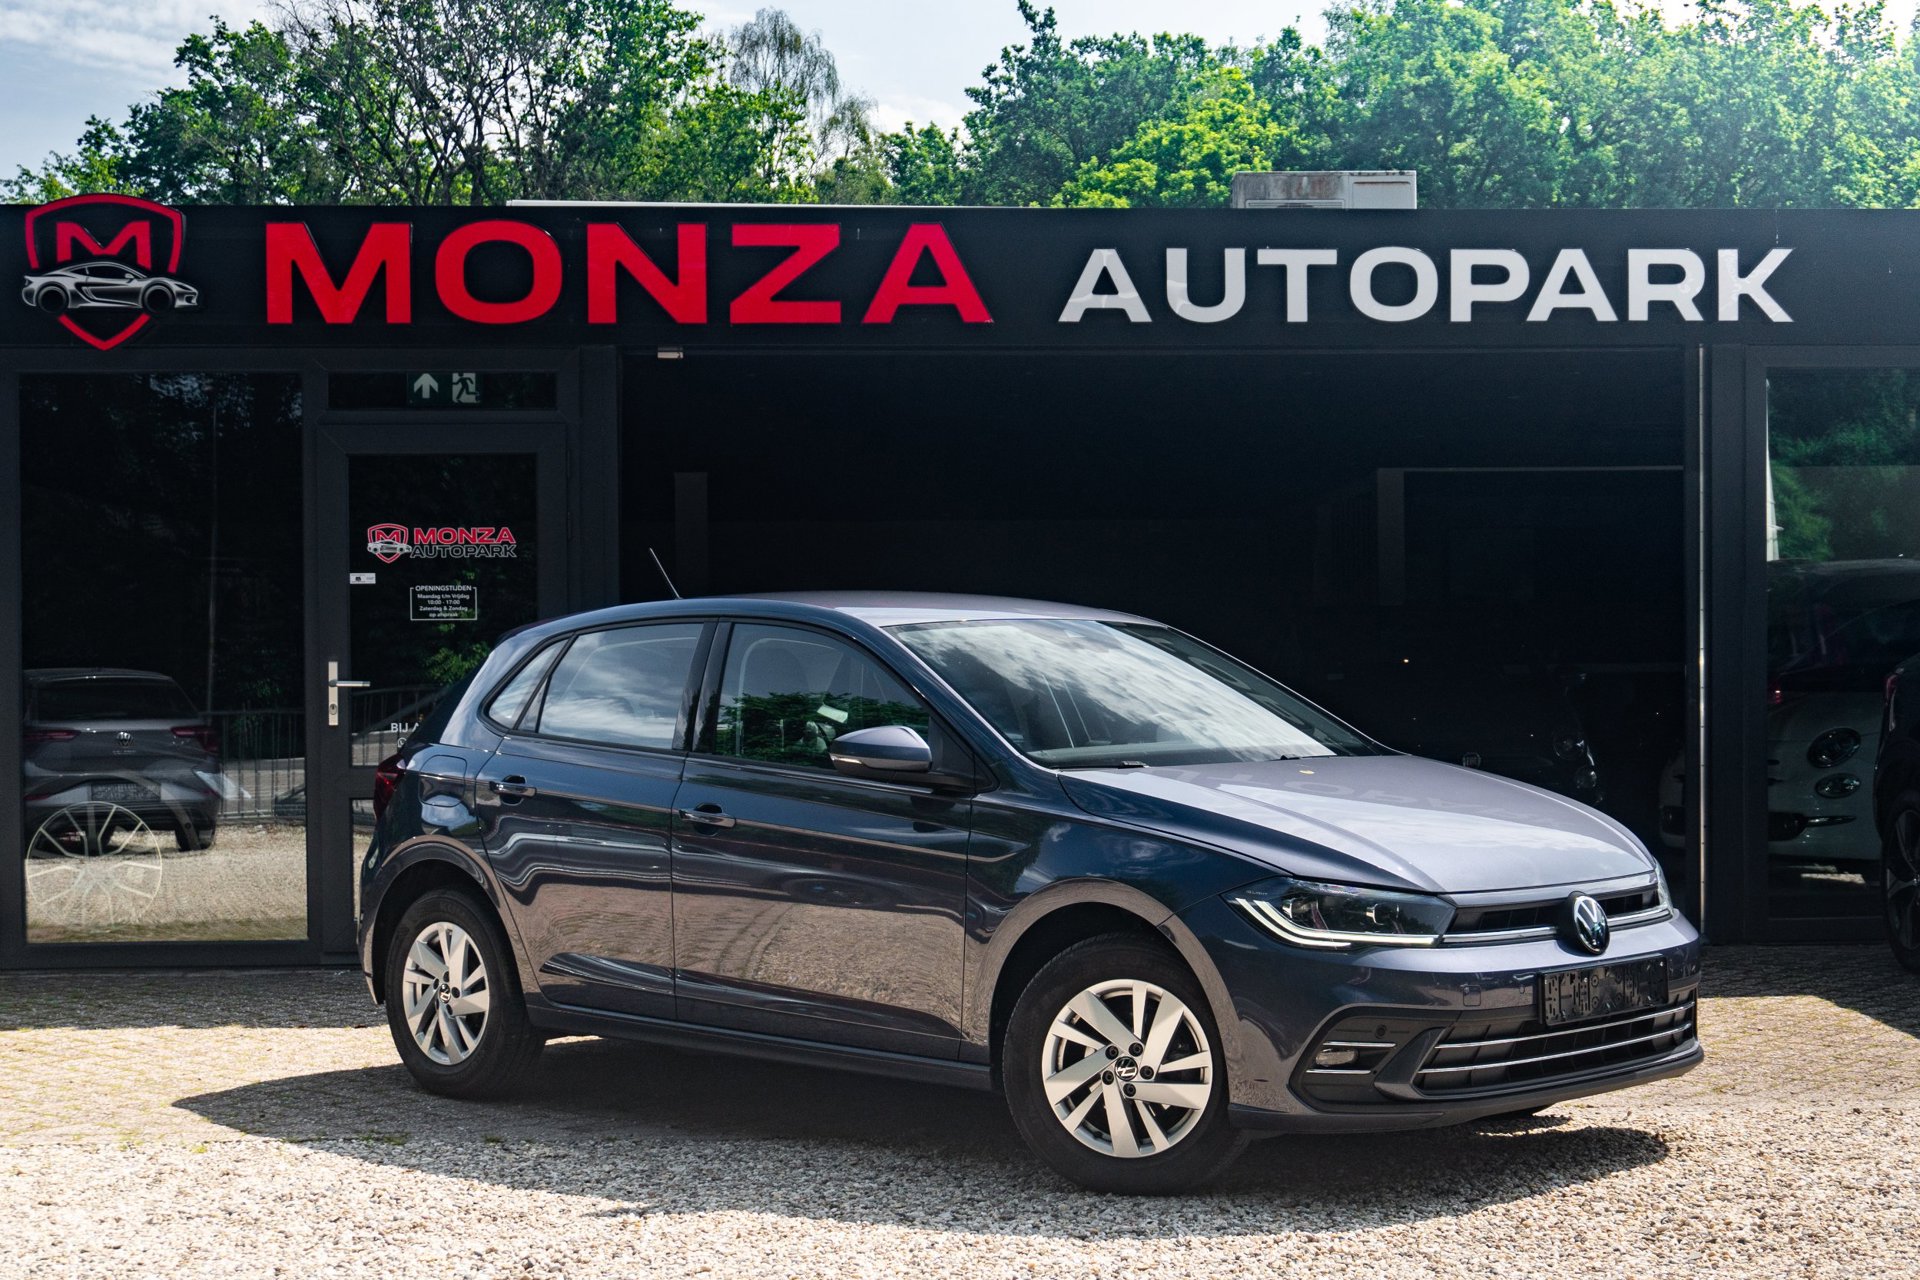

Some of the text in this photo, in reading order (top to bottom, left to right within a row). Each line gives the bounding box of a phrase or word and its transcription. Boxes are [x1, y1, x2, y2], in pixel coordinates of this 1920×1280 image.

[266, 222, 1794, 325] MONZA AUTOPARK
[413, 527, 517, 545] MONZA
[410, 544, 517, 558] AUTOPARK
[391, 723, 408, 733] BIJ
